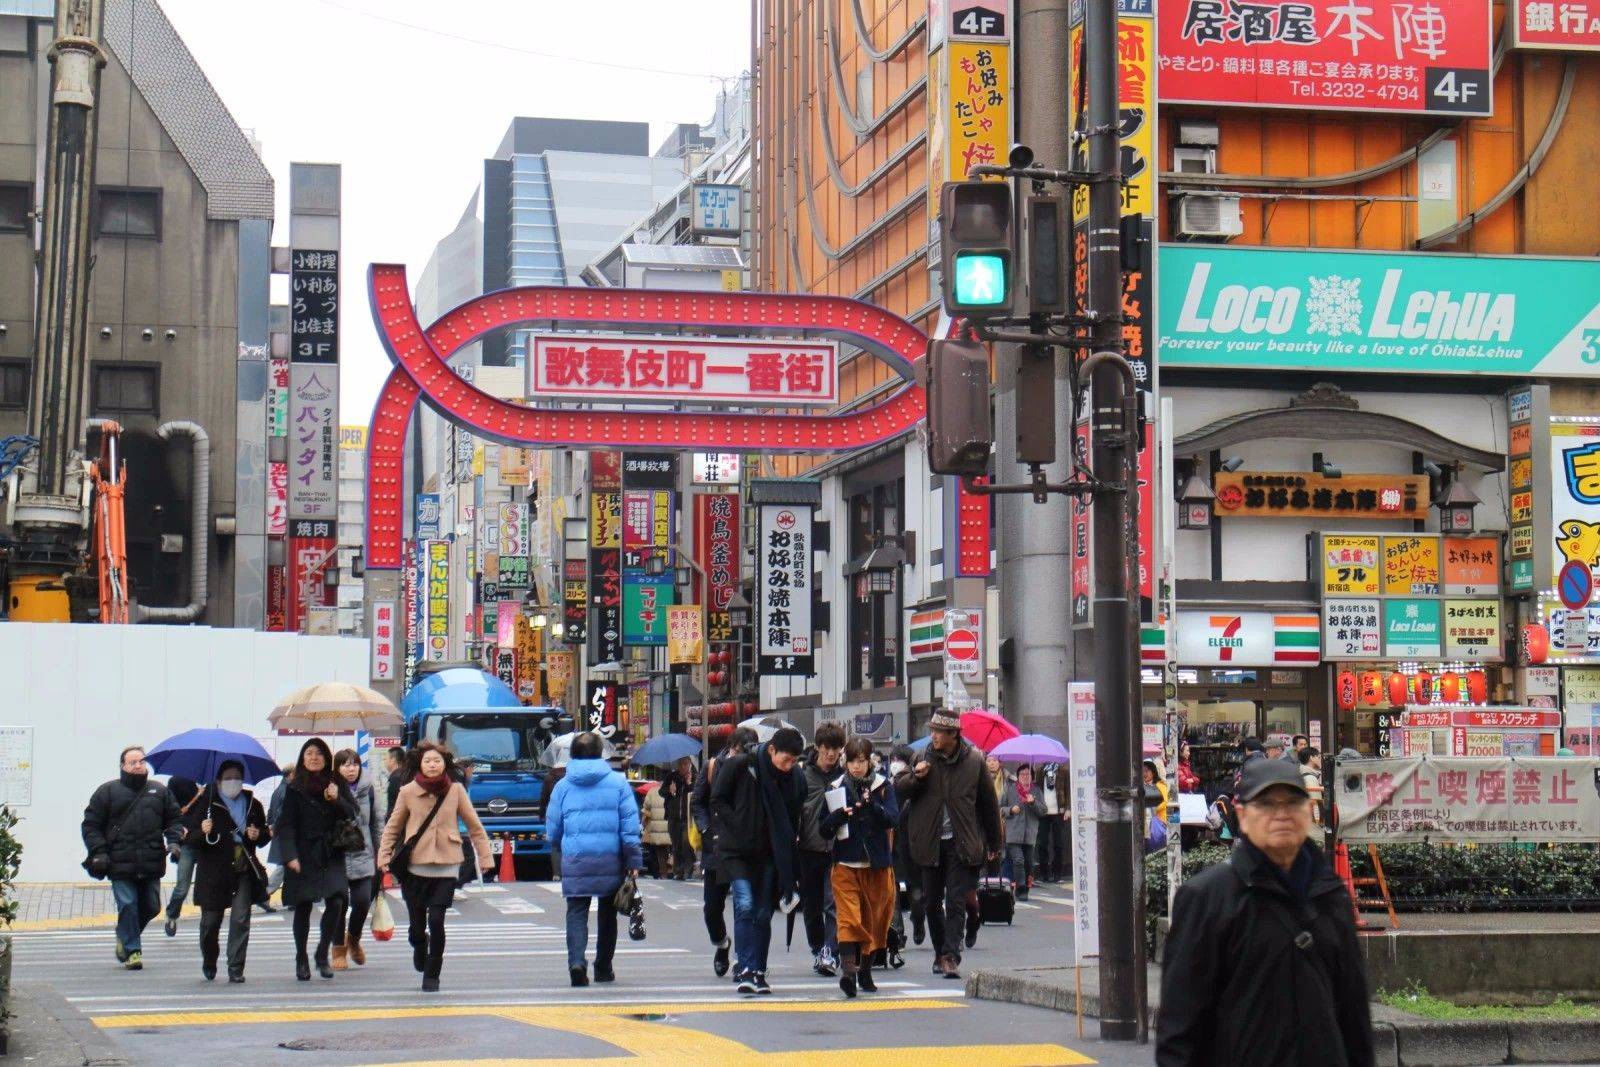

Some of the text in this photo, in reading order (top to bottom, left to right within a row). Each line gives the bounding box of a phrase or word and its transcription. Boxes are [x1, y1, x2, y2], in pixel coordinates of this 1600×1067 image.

[961, 12, 995, 34] 4F
[976, 50, 1003, 106] お好み
[959, 57, 993, 132] もんじゃ
[1290, 81, 1419, 101] Tel.3232-4794
[1433, 71, 1477, 103] 4F
[954, 101, 978, 137] たこ
[294, 253, 337, 270] 小料理
[293, 278, 308, 334] いろは
[321, 277, 337, 335] あづま
[299, 342, 331, 356] 3F
[1159, 335, 1222, 351] Forever
[1226, 339, 1263, 354] your
[1267, 340, 1322, 355] beauty
[1326, 340, 1354, 355] like
[1358, 345, 1367, 356] a
[1372, 342, 1404, 357] love
[1409, 342, 1425, 357] of
[544, 346, 824, 392] 歌舞伎町一番街
[303, 504, 321, 514] 3F
[297, 521, 329, 537] 焼肉
[710, 496, 732, 609] 焼鳥釜めし
[1386, 538, 1421, 558] お好み
[626, 552, 640, 565] 1F
[1386, 548, 1432, 571] もんじゃ
[1448, 549, 1493, 565] お好み焼
[1385, 569, 1409, 585] たこ
[1410, 565, 1438, 582] 焼き
[768, 529, 791, 647] お好み焼本陣
[1465, 586, 1476, 594] 8F
[710, 612, 730, 626] 1F
[1328, 615, 1377, 627] お好み焼
[377, 607, 391, 677] 劇場通り
[709, 628, 732, 640] 2F
[1337, 629, 1362, 640] 本陣
[1346, 643, 1358, 653] 2F
[774, 657, 795, 669] 2F
[1500, 713, 1538, 725] スクラッチ
[1365, 768, 1579, 806] 路上喫煙禁止
[1367, 808, 1450, 821] 新宿区条例により
